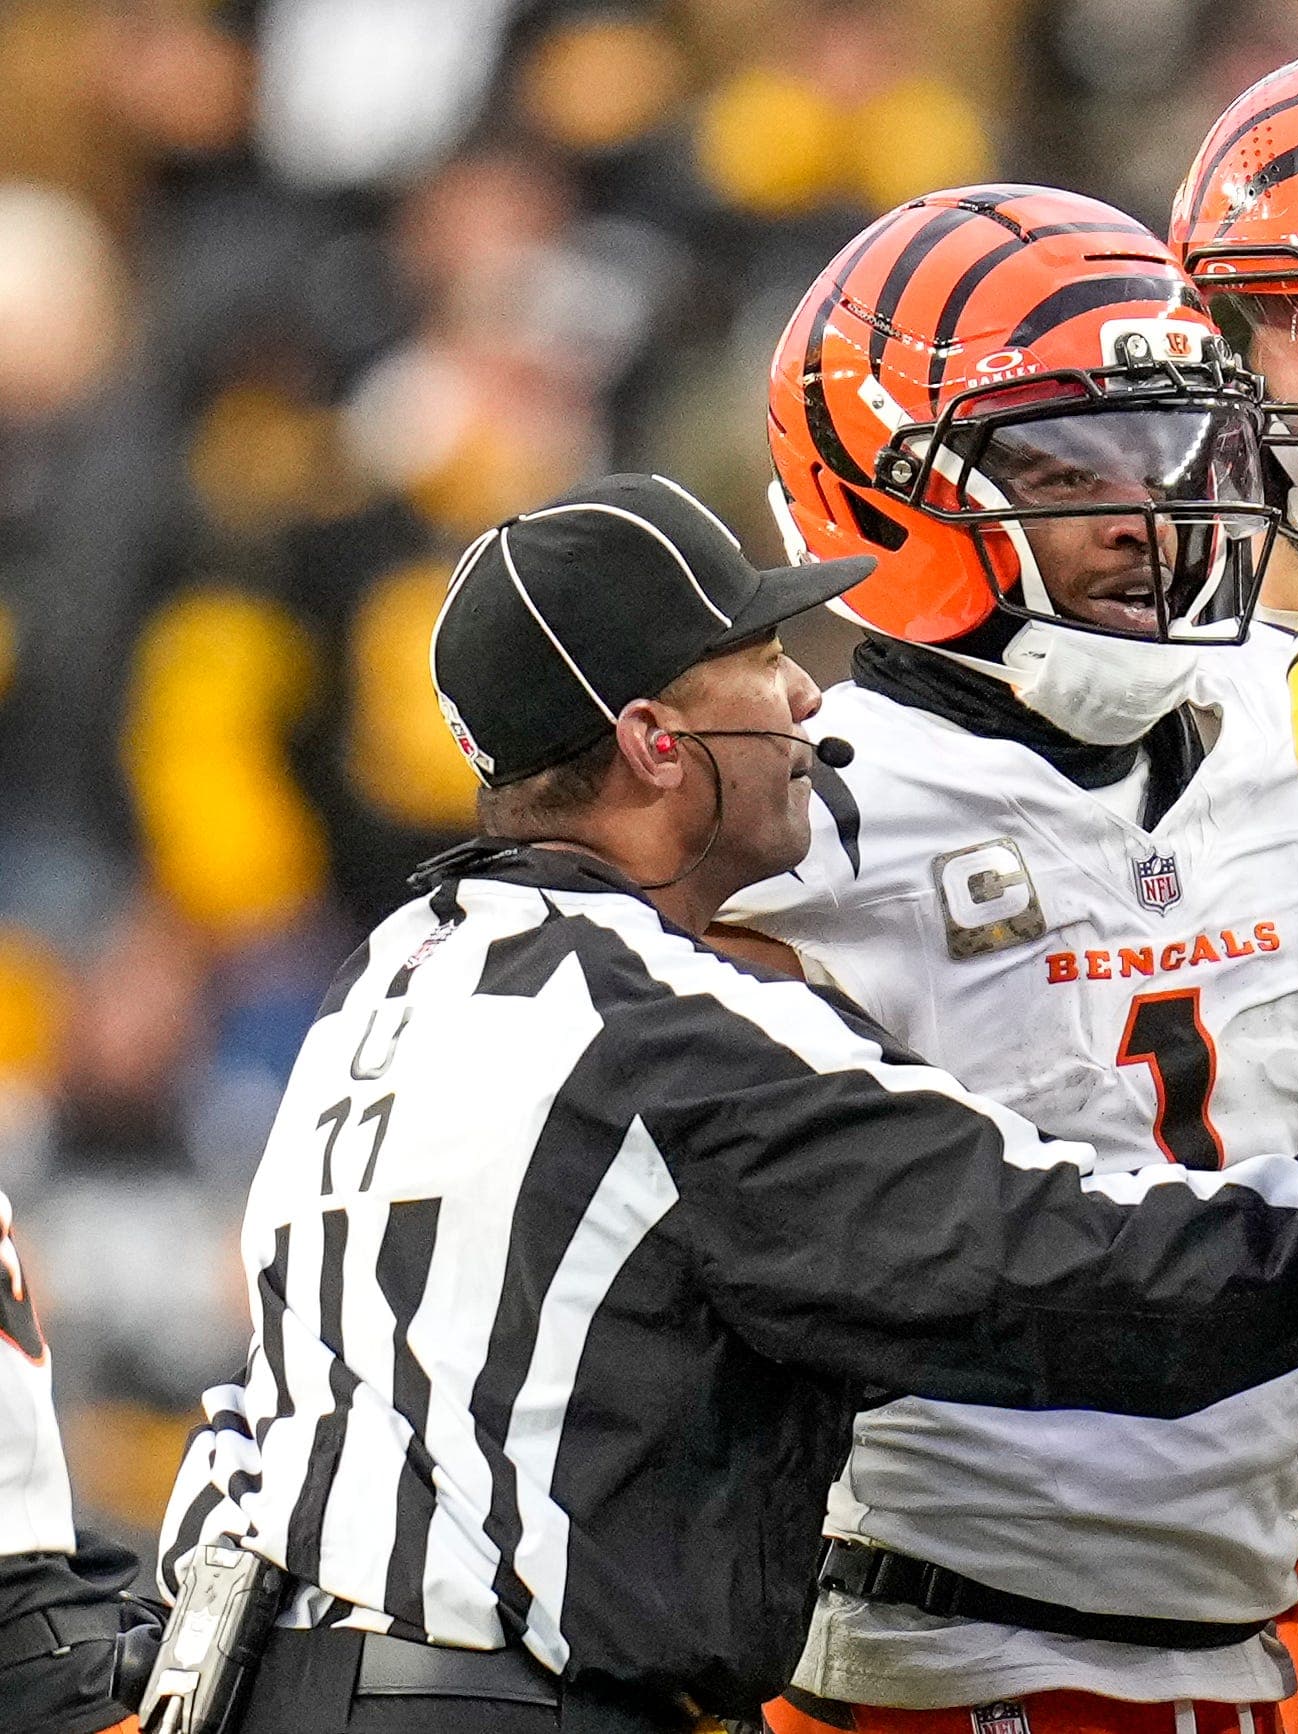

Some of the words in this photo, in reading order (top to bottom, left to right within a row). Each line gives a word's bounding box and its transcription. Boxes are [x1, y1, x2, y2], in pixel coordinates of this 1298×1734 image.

[942, 845, 1031, 929] C
[1144, 876, 1177, 903] NFL
[1045, 921, 1281, 984] BENGALS
[1116, 986, 1225, 1170] 1
[315, 1092, 396, 1196] 11
